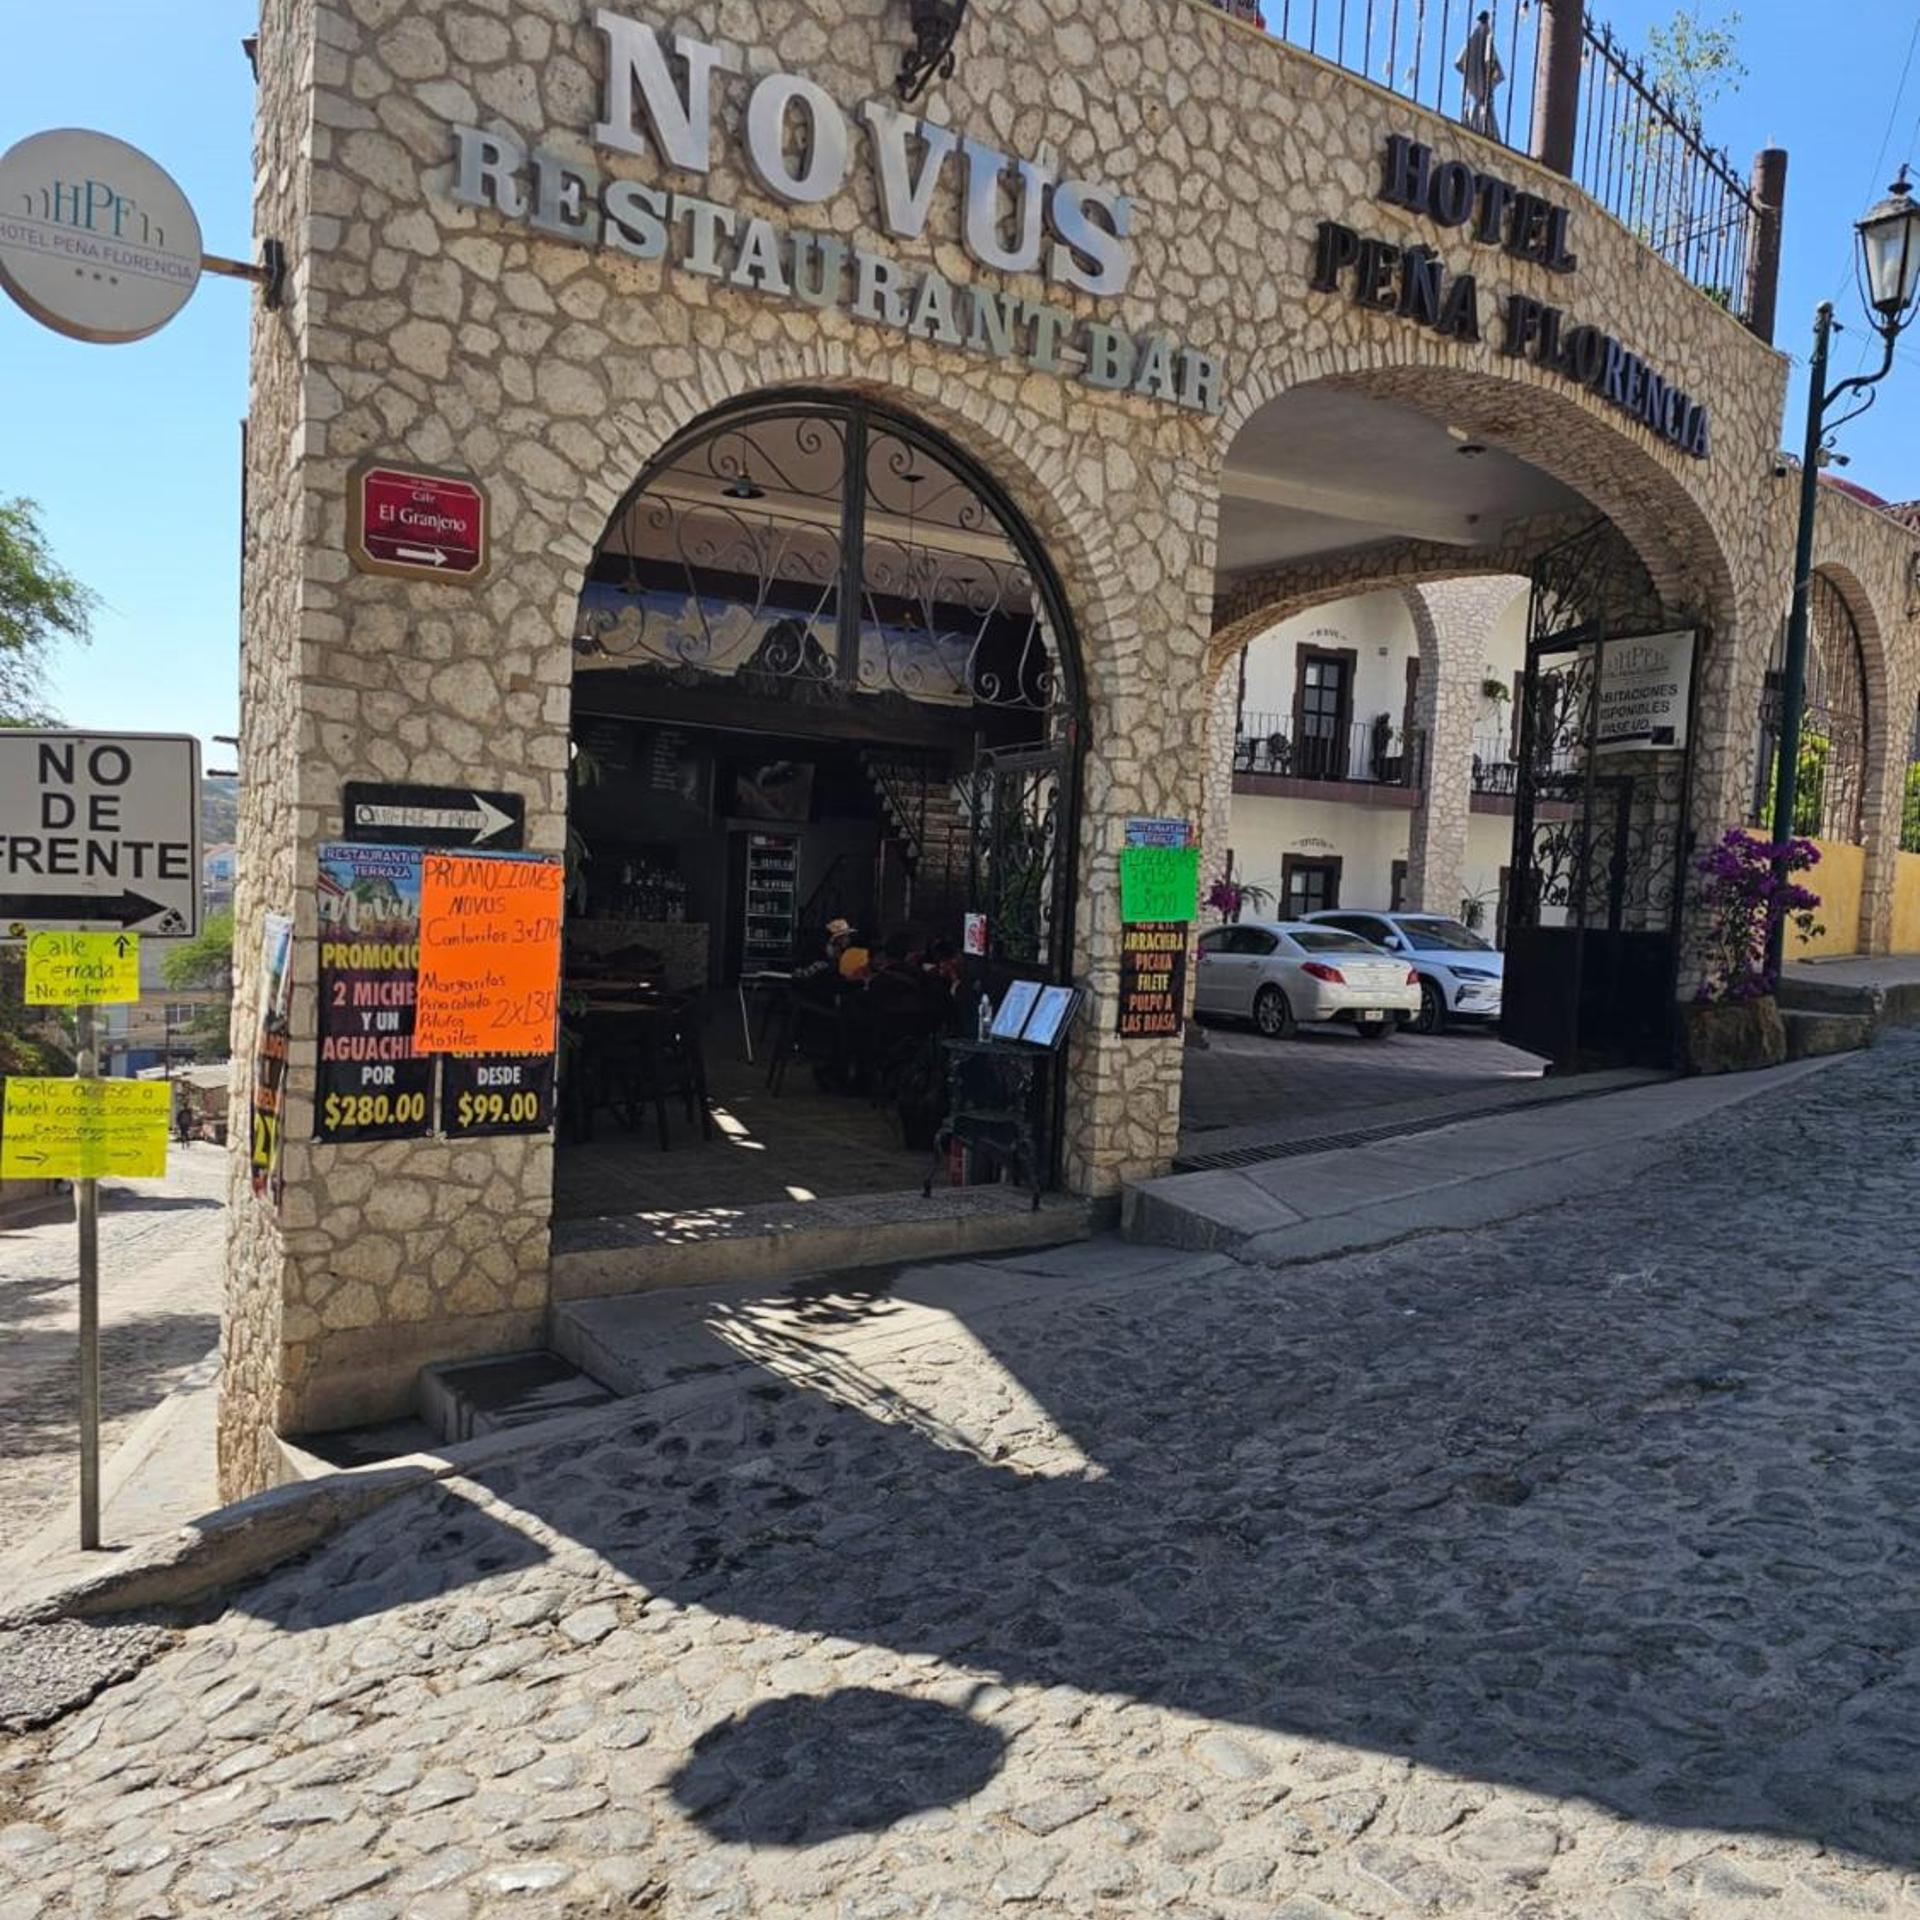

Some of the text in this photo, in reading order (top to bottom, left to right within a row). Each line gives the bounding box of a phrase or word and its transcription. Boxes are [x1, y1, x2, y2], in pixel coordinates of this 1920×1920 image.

[594, 8, 1136, 295] NOVUS
[1380, 133, 1577, 273] HOTEL
[103, 249, 193, 280] FLORENCIA
[1312, 221, 1711, 459] PEÑA FLORENCIA
[379, 504, 394, 522] El
[38, 743, 131, 786] NO
[41, 792, 120, 832] DE
[0, 835, 189, 880] RENTE
[354, 865, 411, 878] TERRAZA
[448, 896, 506, 917] NOVUS
[31, 932, 87, 957] Calle
[1125, 932, 1184, 951] ARRACHERA
[33, 957, 114, 981] Cerrada
[333, 982, 346, 1005] 2
[1138, 974, 1169, 991] FILETE
[361, 1012, 399, 1031] Y UN
[322, 1036, 430, 1061] AGUACHI
[361, 1066, 395, 1084] POR
[477, 1066, 521, 1085] DESDE
[324, 1092, 425, 1130] $280.00
[458, 1091, 538, 1128] $99.00
